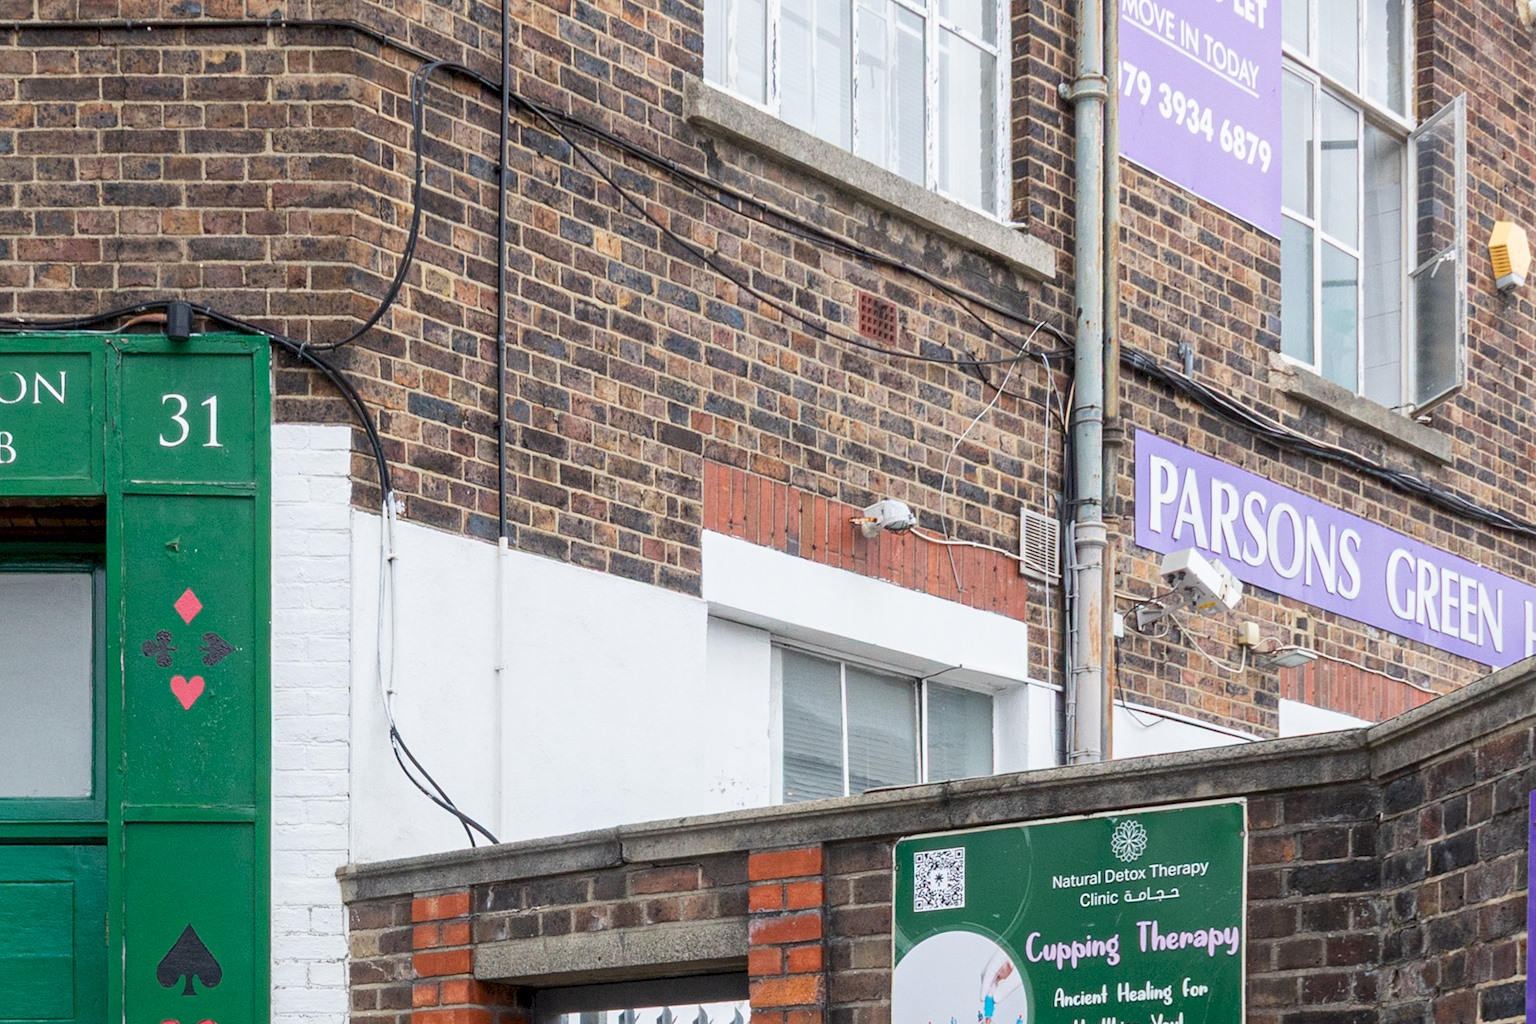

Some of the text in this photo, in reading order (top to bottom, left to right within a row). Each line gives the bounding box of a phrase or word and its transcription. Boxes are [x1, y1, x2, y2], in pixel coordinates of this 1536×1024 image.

[1180, 19, 1199, 55] IN
[1203, 33, 1260, 90] TODAY
[1118, 60, 1272, 174] 79 3934 6879
[159, 394, 223, 447] 31
[1149, 454, 1362, 600] PARSONS
[1386, 548, 1503, 654] GREEN
[1052, 860, 1209, 889] Natural Detox Therapy
[1080, 891, 1119, 908] Clinic
[1025, 920, 1239, 970] Cupping Therapy
[1054, 984, 1108, 1008] Ancient
[1117, 981, 1173, 1006] Healing
